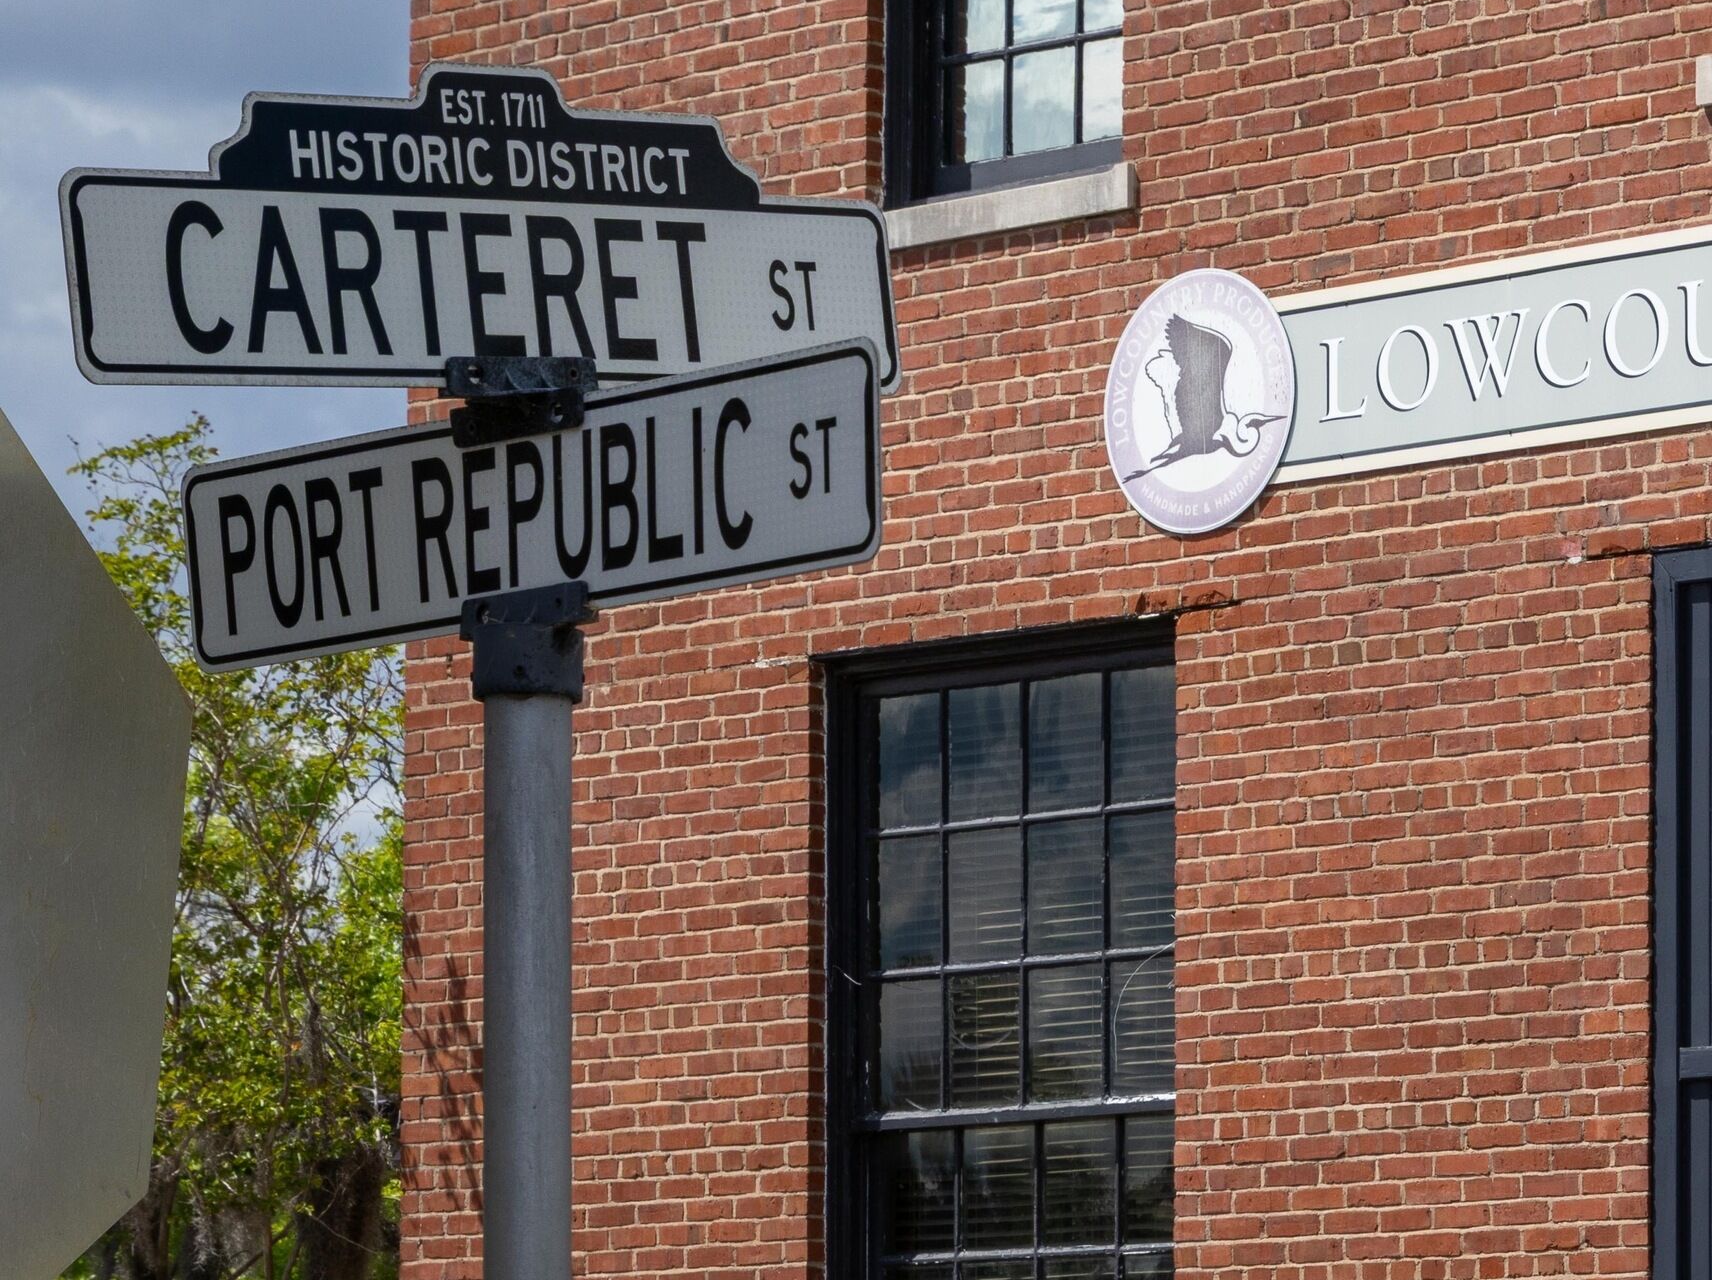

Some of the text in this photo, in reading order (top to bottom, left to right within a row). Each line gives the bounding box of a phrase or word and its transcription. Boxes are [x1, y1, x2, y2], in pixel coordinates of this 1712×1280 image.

[289, 129, 690, 196] HISTORIC DISTRICT
[440, 87, 547, 129] EST. 1711
[165, 200, 817, 363] CARTERET ST
[1111, 282, 1208, 450] LOWCOUNTRY
[217, 397, 838, 637] PORT REPUBLIC ST
[1141, 482, 1199, 517] HANDMADE
[1214, 433, 1274, 510] HANDPACKED
